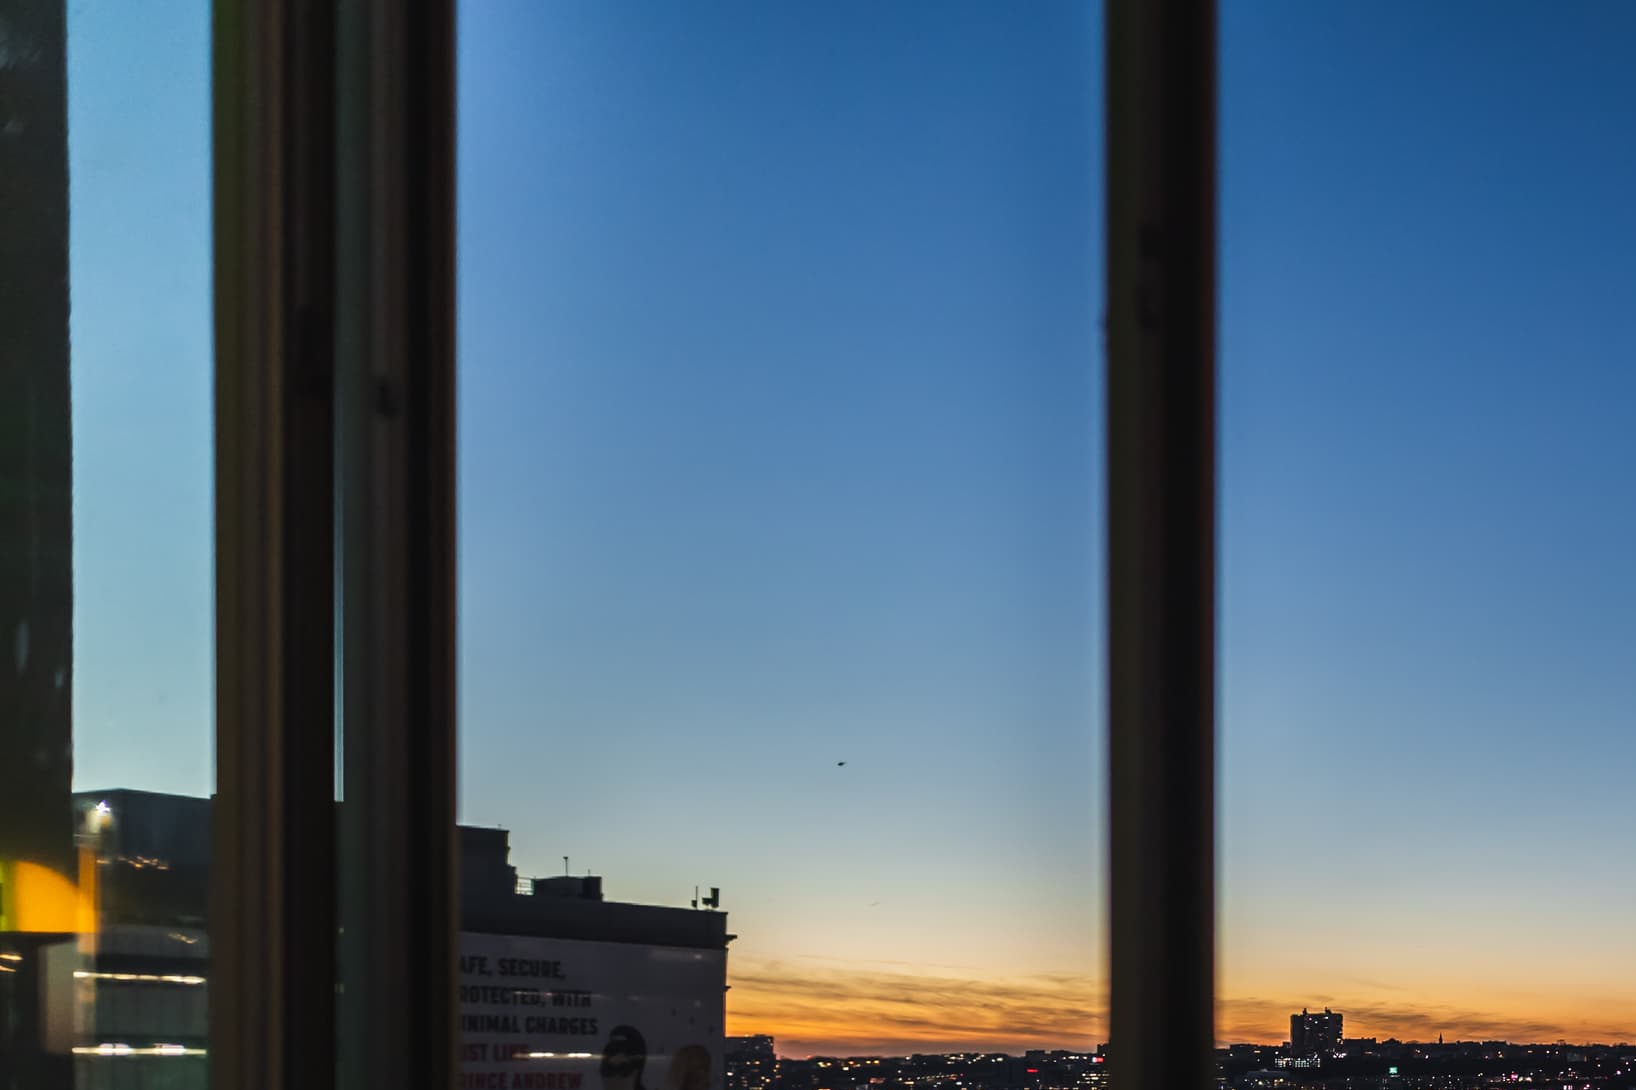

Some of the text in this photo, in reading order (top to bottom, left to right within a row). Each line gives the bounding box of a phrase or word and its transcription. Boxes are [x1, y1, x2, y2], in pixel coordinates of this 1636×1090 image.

[497, 958, 567, 980] SECURE,
[551, 988, 592, 1007] WITH
[525, 1016, 598, 1036] CHARGES
[511, 1072, 583, 1090] ANDREW
